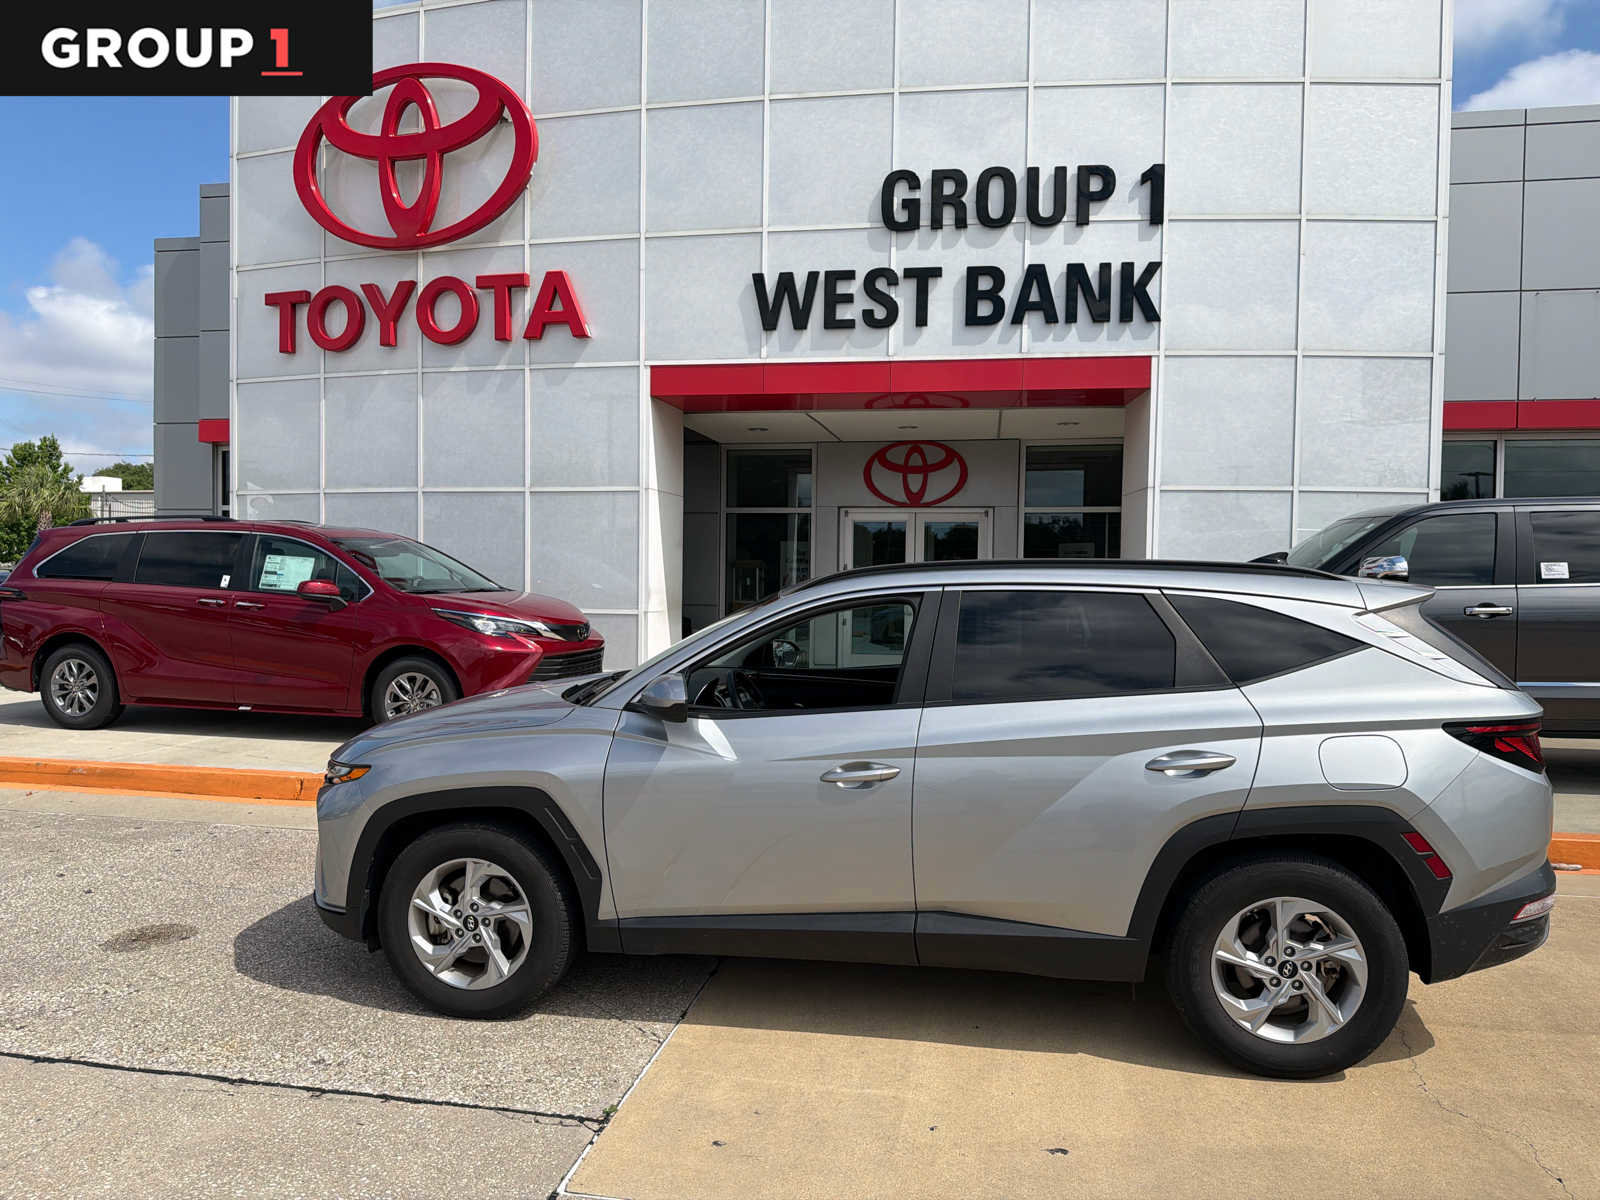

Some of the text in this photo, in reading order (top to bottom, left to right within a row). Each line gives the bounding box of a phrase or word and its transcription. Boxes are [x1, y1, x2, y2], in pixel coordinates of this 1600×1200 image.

[881, 163, 1166, 232] GROUP 1
[265, 270, 592, 355] TOYOTA
[752, 261, 1162, 331] WEST BANK
